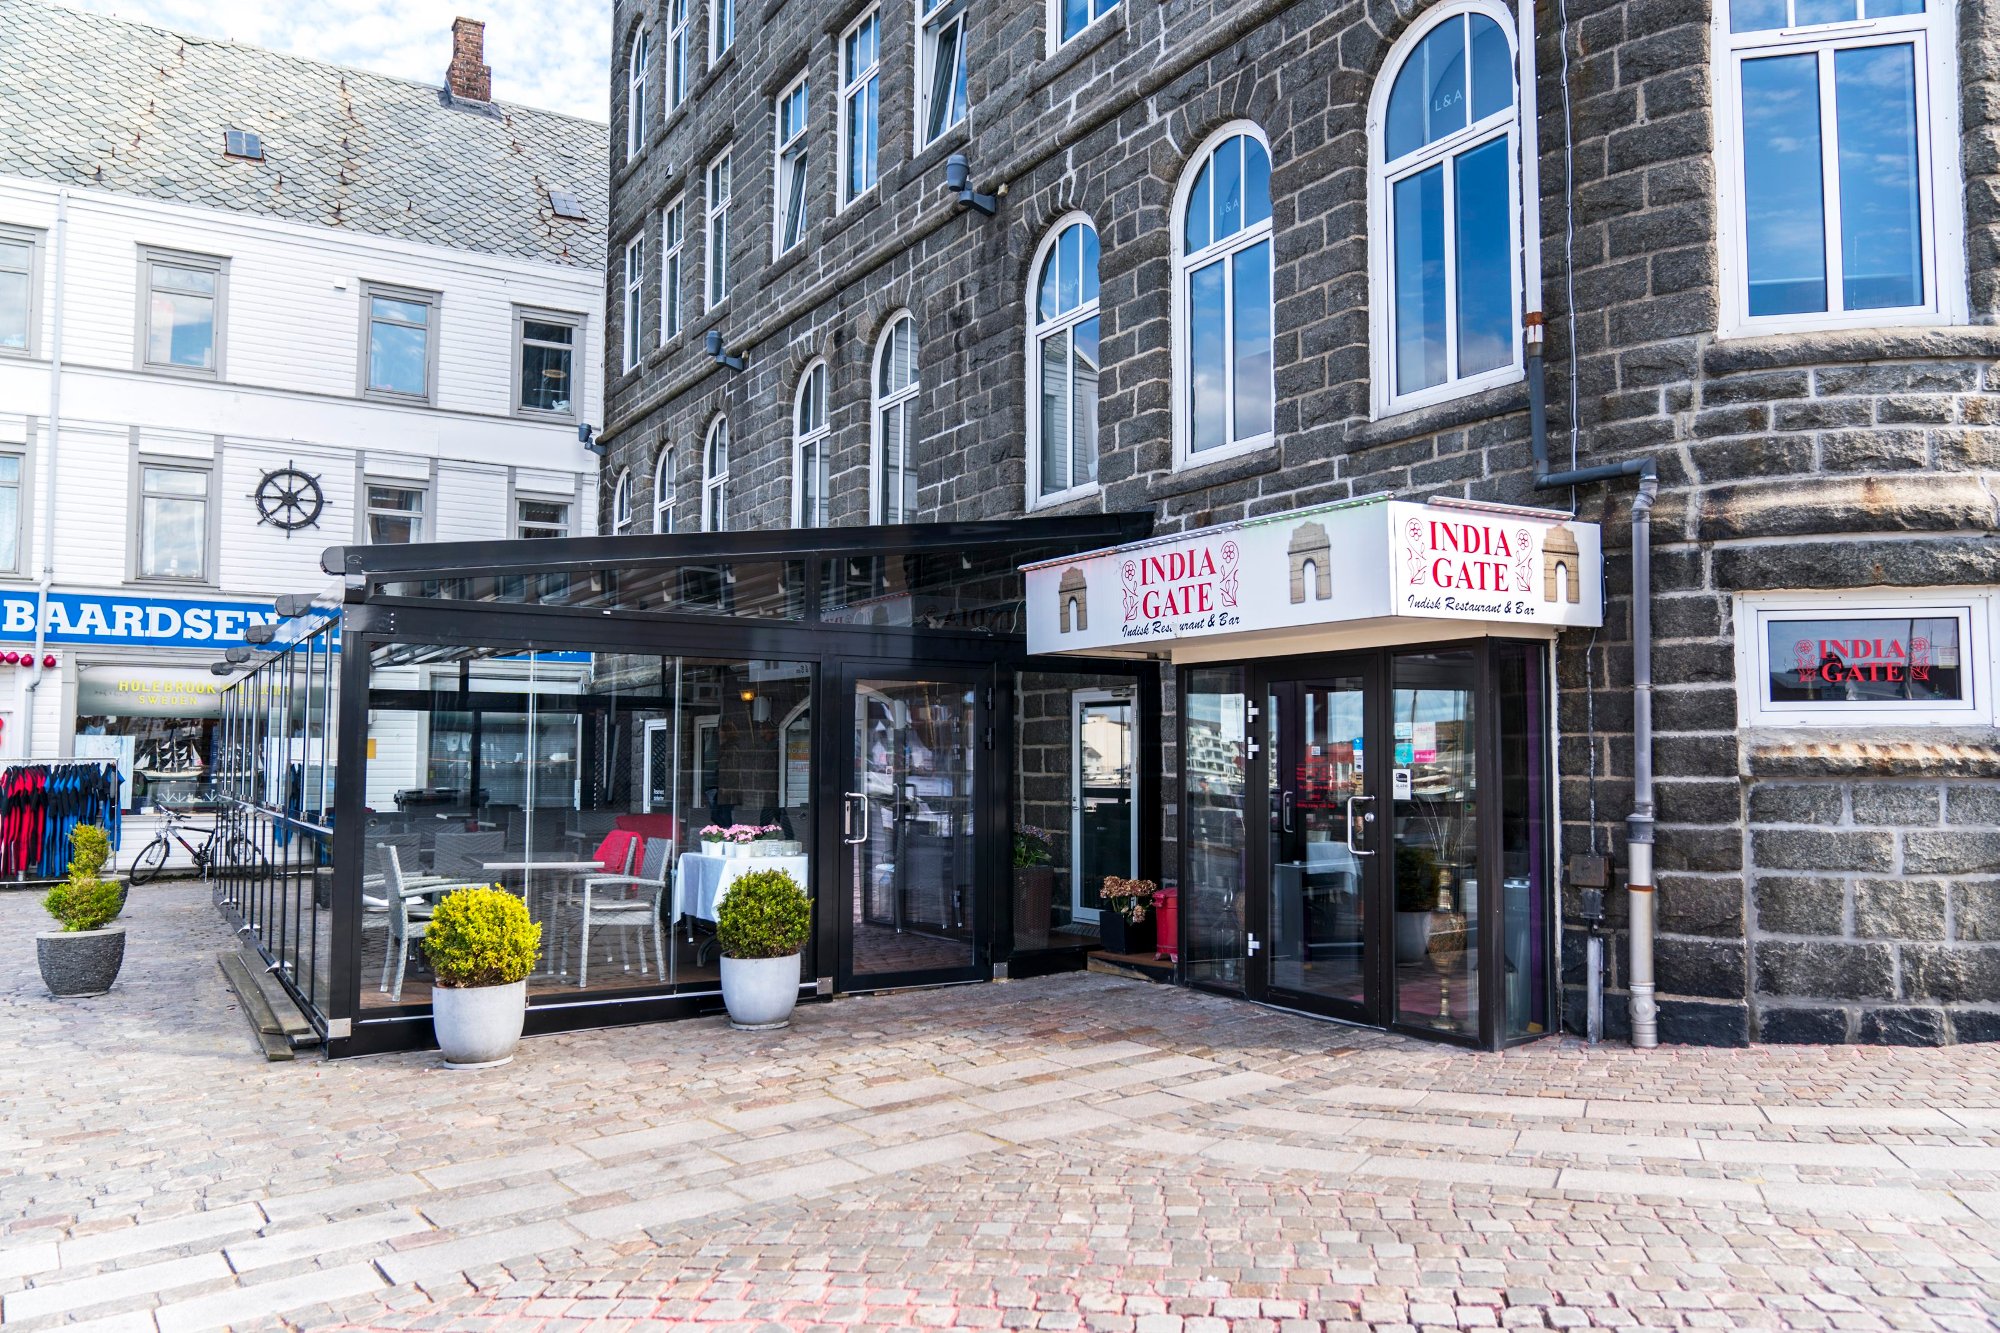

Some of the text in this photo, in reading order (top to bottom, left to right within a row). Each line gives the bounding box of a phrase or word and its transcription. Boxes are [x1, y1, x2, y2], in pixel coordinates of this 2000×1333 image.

[1428, 520, 1513, 557] INDIA
[1140, 547, 1217, 586] INDIA
[1432, 557, 1510, 592] GATE
[1142, 582, 1214, 619] GATE
[1408, 594, 1535, 615] Indisk Restaurant & Bar
[1122, 612, 1240, 638] Indisk Resurant & Bar
[1818, 638, 1906, 660] INDIA
[1821, 661, 1903, 682] GATE
[139, 695, 197, 705] SWEDEN
